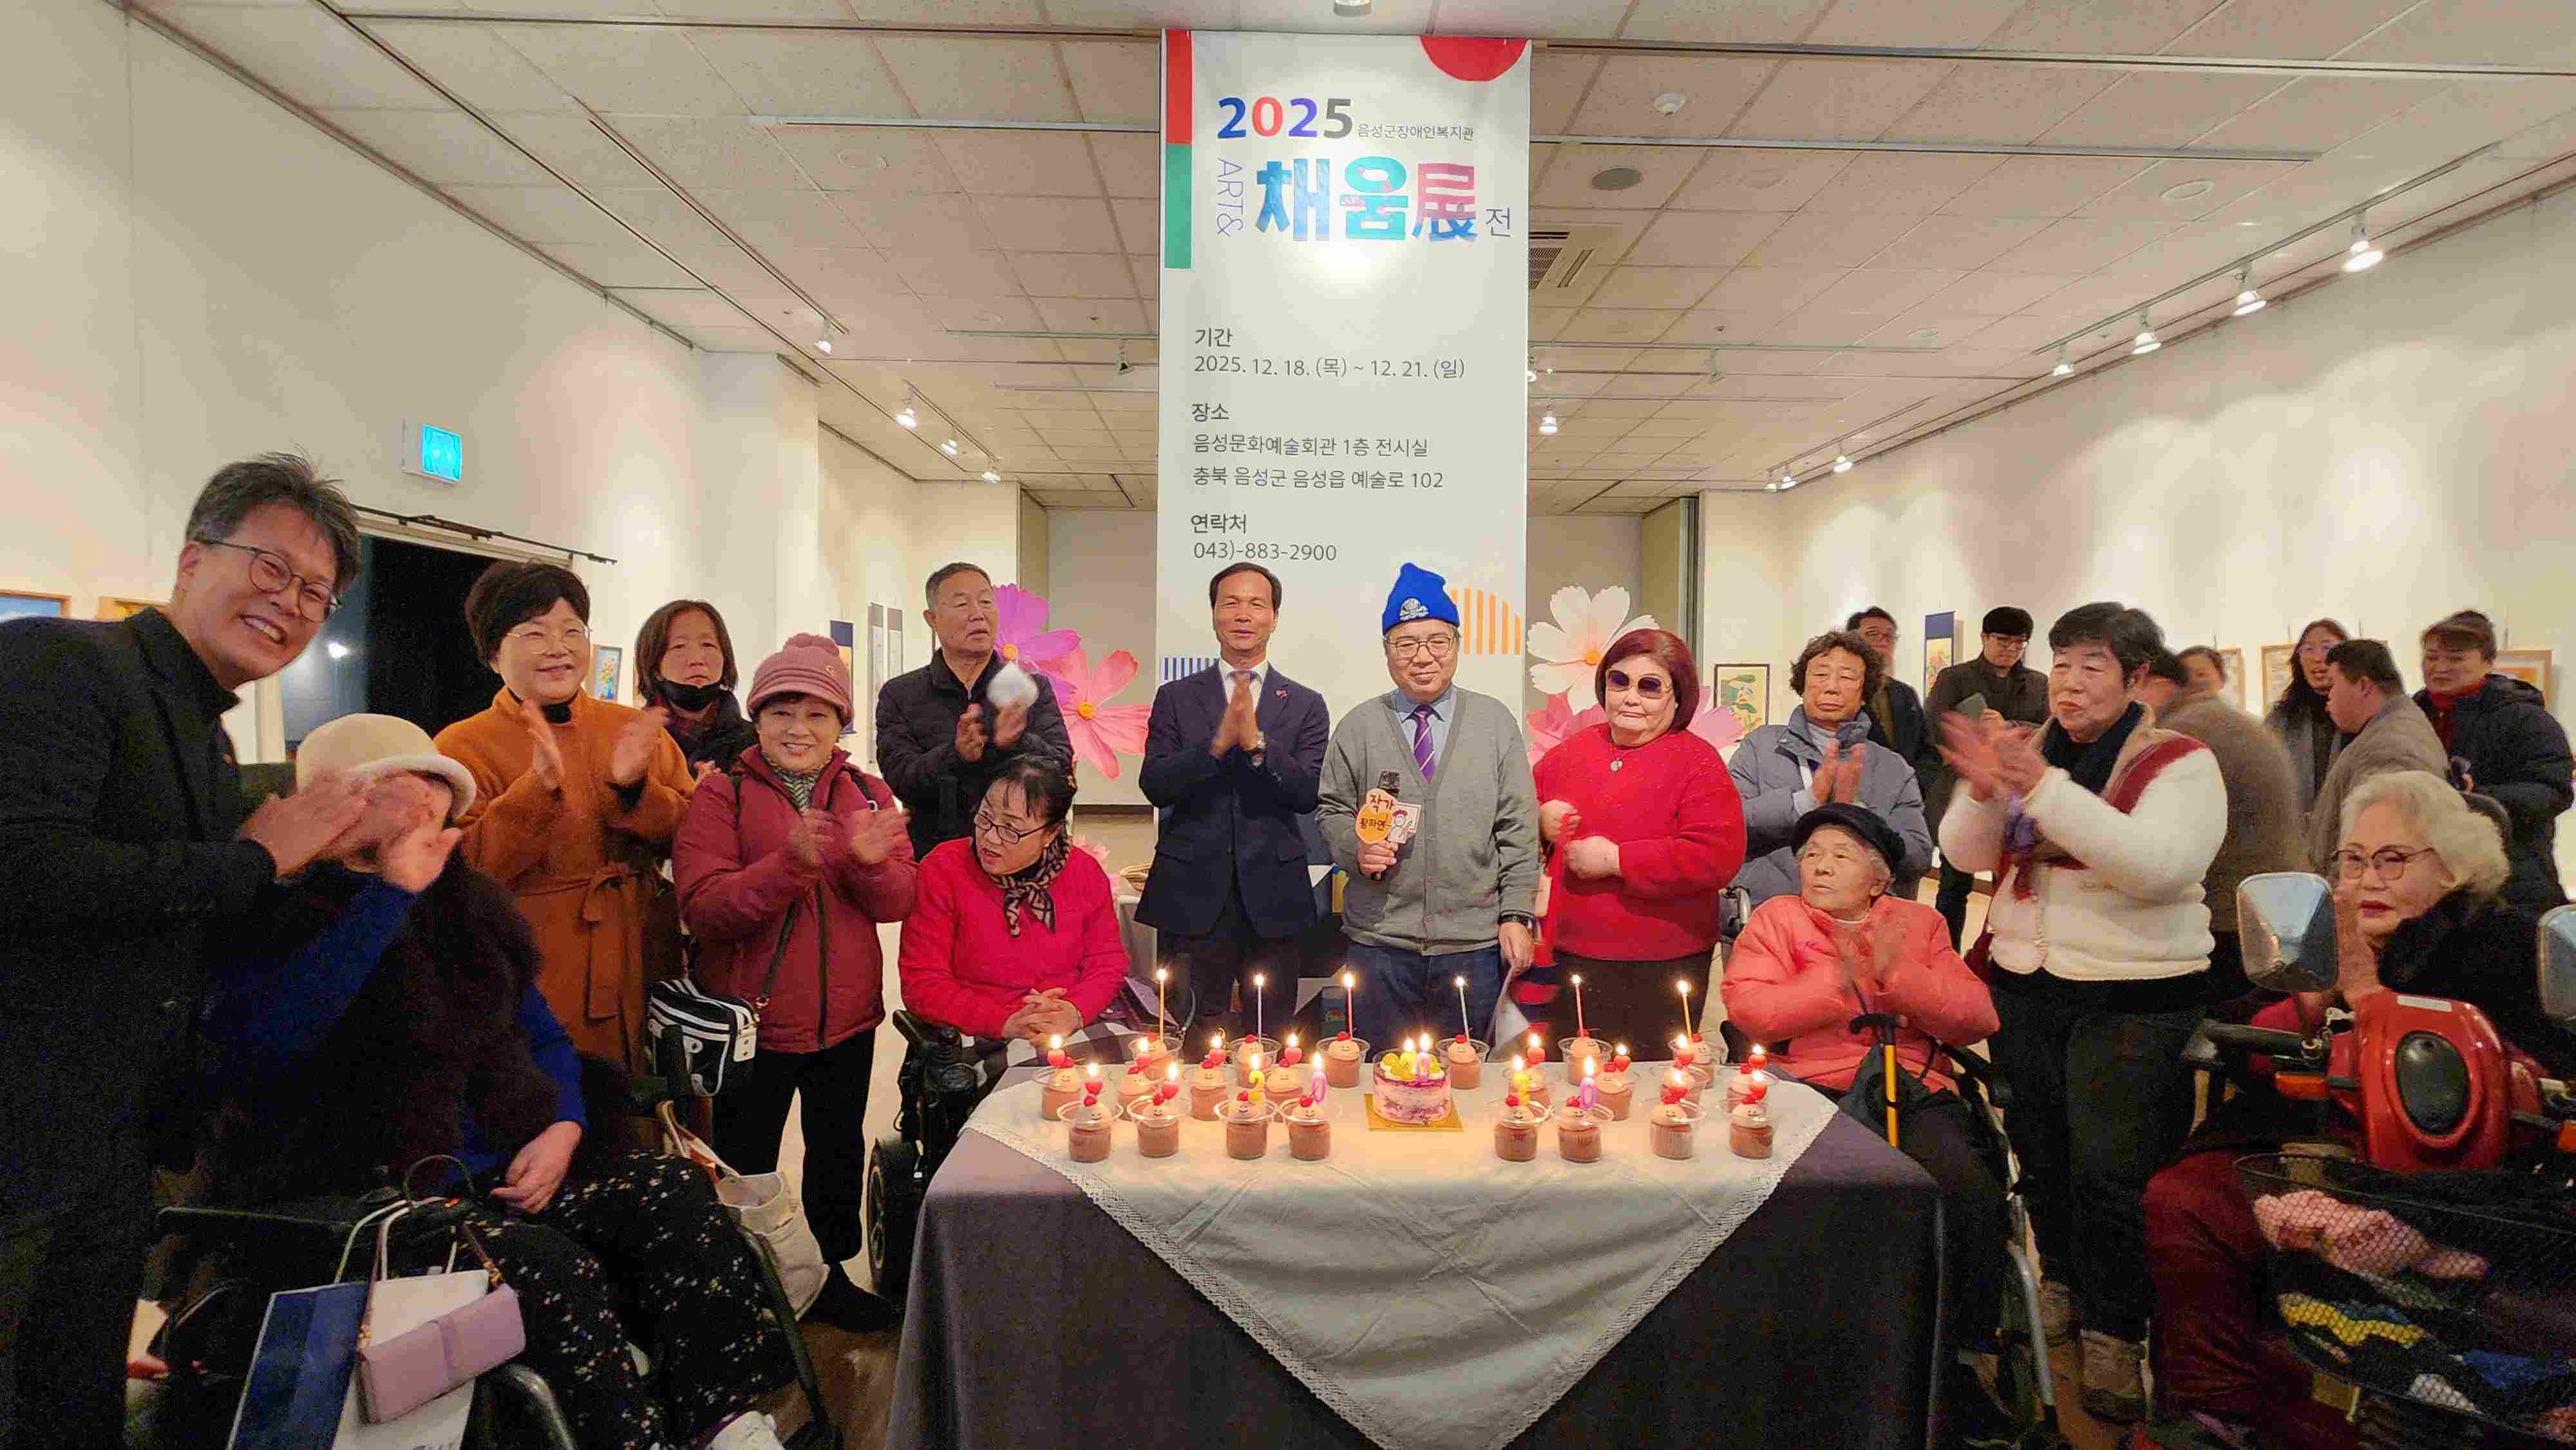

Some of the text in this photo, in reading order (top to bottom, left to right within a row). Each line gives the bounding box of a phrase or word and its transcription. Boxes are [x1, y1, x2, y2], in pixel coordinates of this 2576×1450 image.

[1217, 97, 1353, 140] 2025
[1358, 124, 1474, 141] 음성군장애인복지관
[1486, 207, 1511, 238] 전
[1195, 328, 1233, 348] 기간
[1194, 355, 1246, 373] 2025.
[1253, 359, 1278, 375] 12.
[1284, 360, 1310, 376] 18.
[1316, 357, 1347, 378] (목)
[1371, 360, 1396, 377] 12.
[1403, 361, 1428, 378] 21.
[1434, 359, 1465, 381] (일)
[1191, 402, 1229, 422] 장소
[1193, 434, 1428, 458] 음성문화예술회관 1층 전시실
[1193, 466, 1443, 489] 충북 음성군 음성읍 예술로 102
[1191, 514, 1247, 534] 연락처
[1194, 540, 1337, 561] 043)-883-2900
